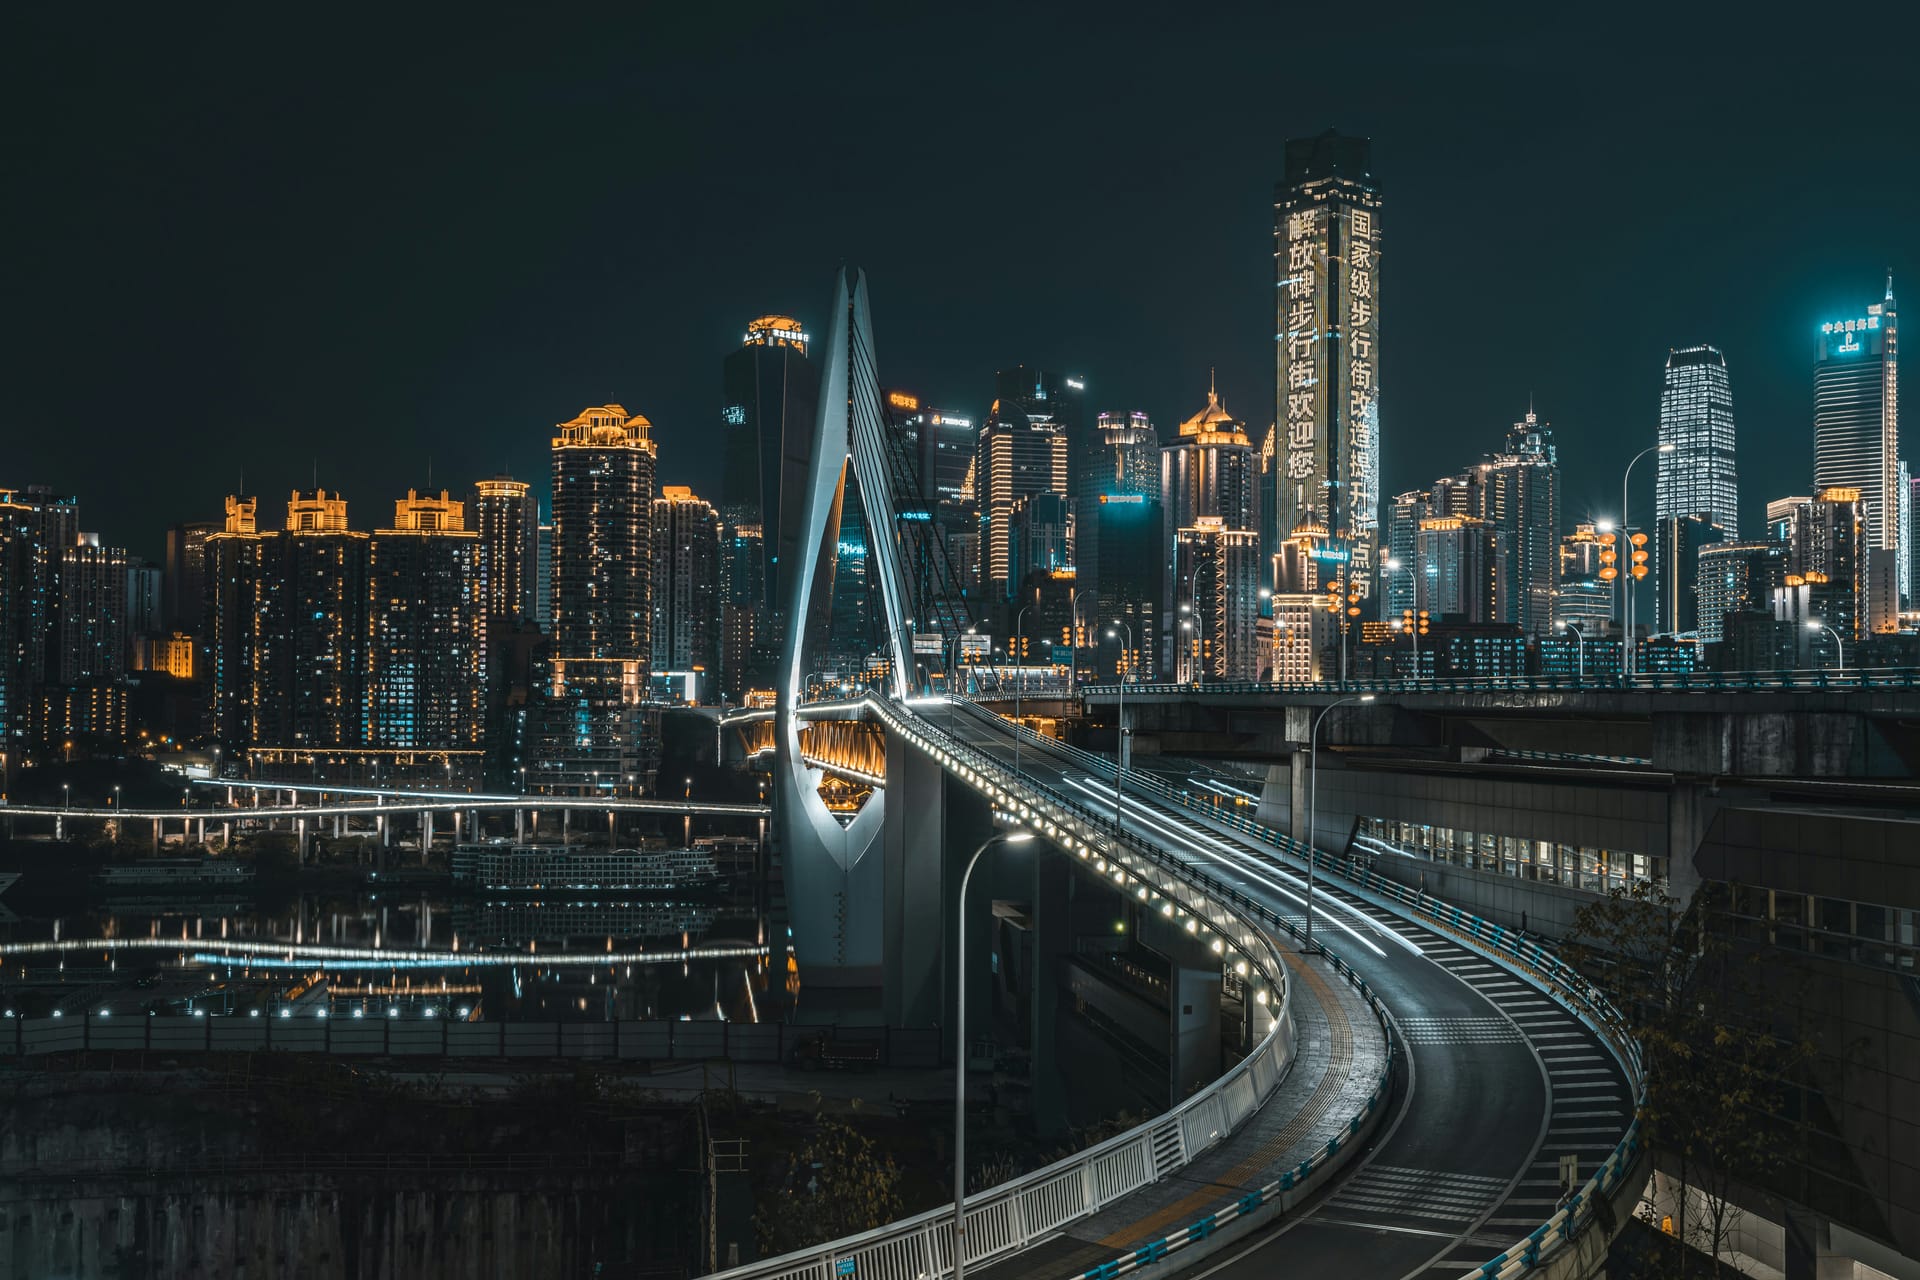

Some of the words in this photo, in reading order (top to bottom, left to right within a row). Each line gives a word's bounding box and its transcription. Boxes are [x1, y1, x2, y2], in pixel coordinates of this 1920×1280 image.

[1822, 316, 1879, 334] 中央商务区
